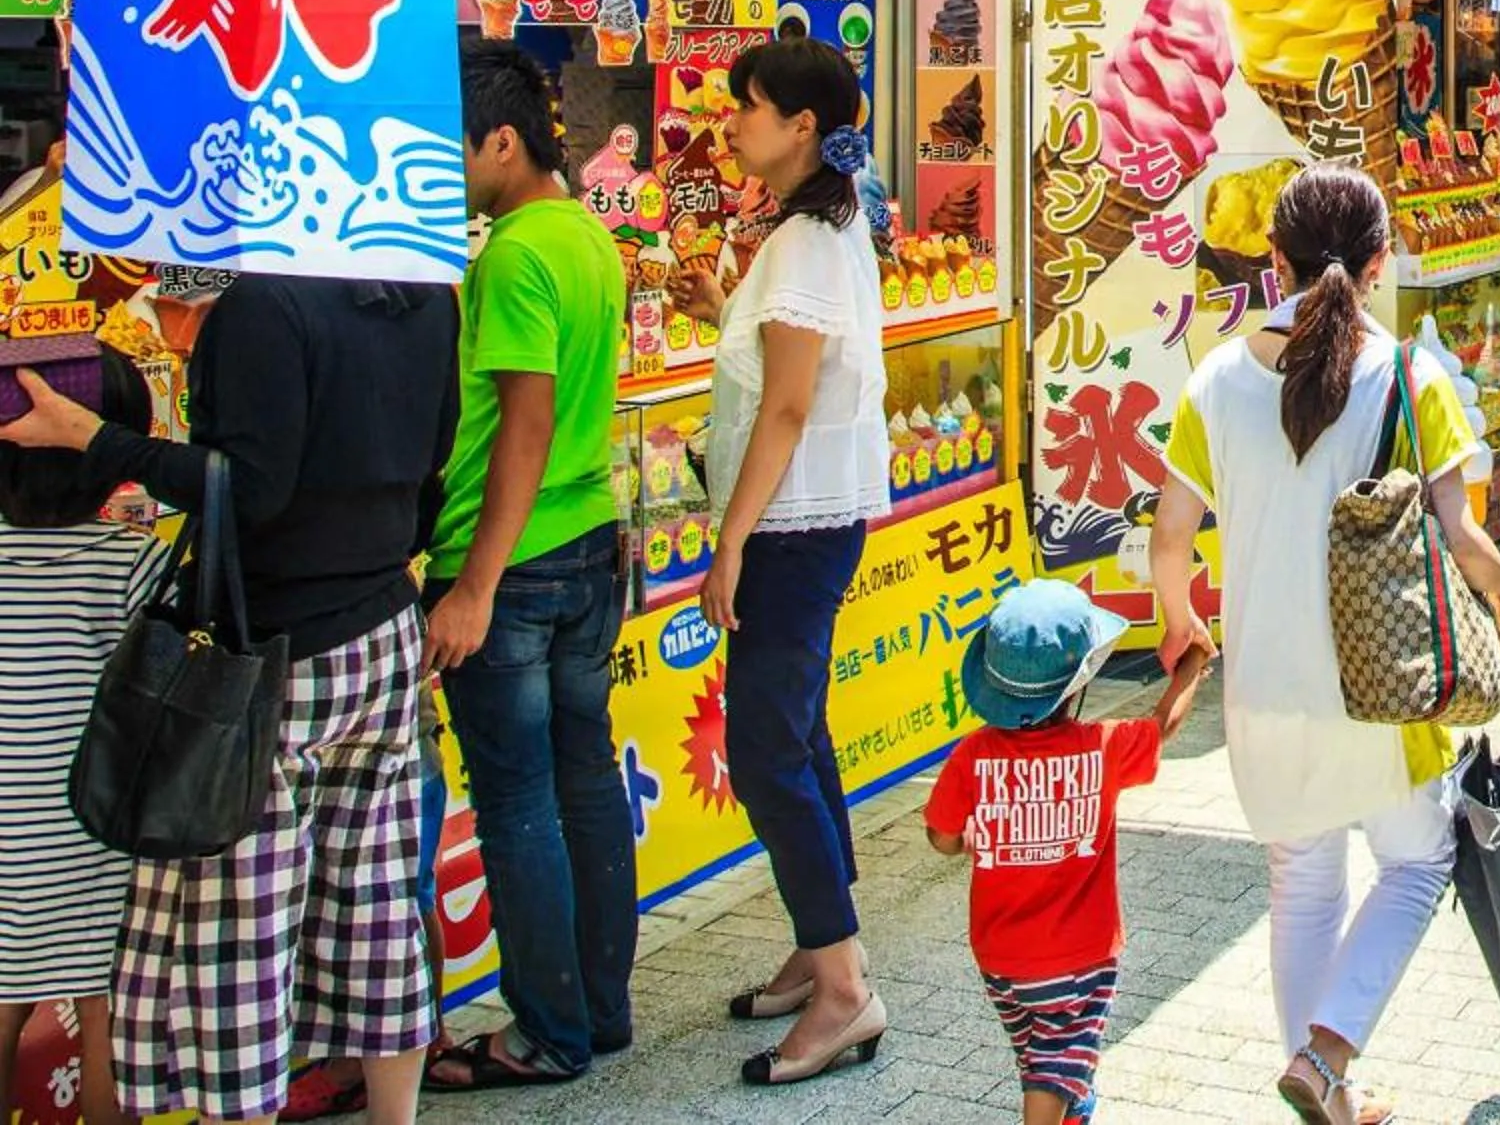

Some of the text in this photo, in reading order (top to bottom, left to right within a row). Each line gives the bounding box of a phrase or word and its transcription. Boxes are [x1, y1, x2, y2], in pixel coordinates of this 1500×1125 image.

[589, 183, 637, 216] もも
[675, 181, 719, 212] モカ
[1119, 143, 1200, 266] もも
[17, 246, 92, 281] いも
[924, 503, 1013, 574] モカ
[839, 554, 919, 607] さんの味わい
[834, 626, 912, 683] 当店一番人気
[975, 794, 1101, 850] STANDARD
[1009, 844, 1065, 863] CLOTHING
